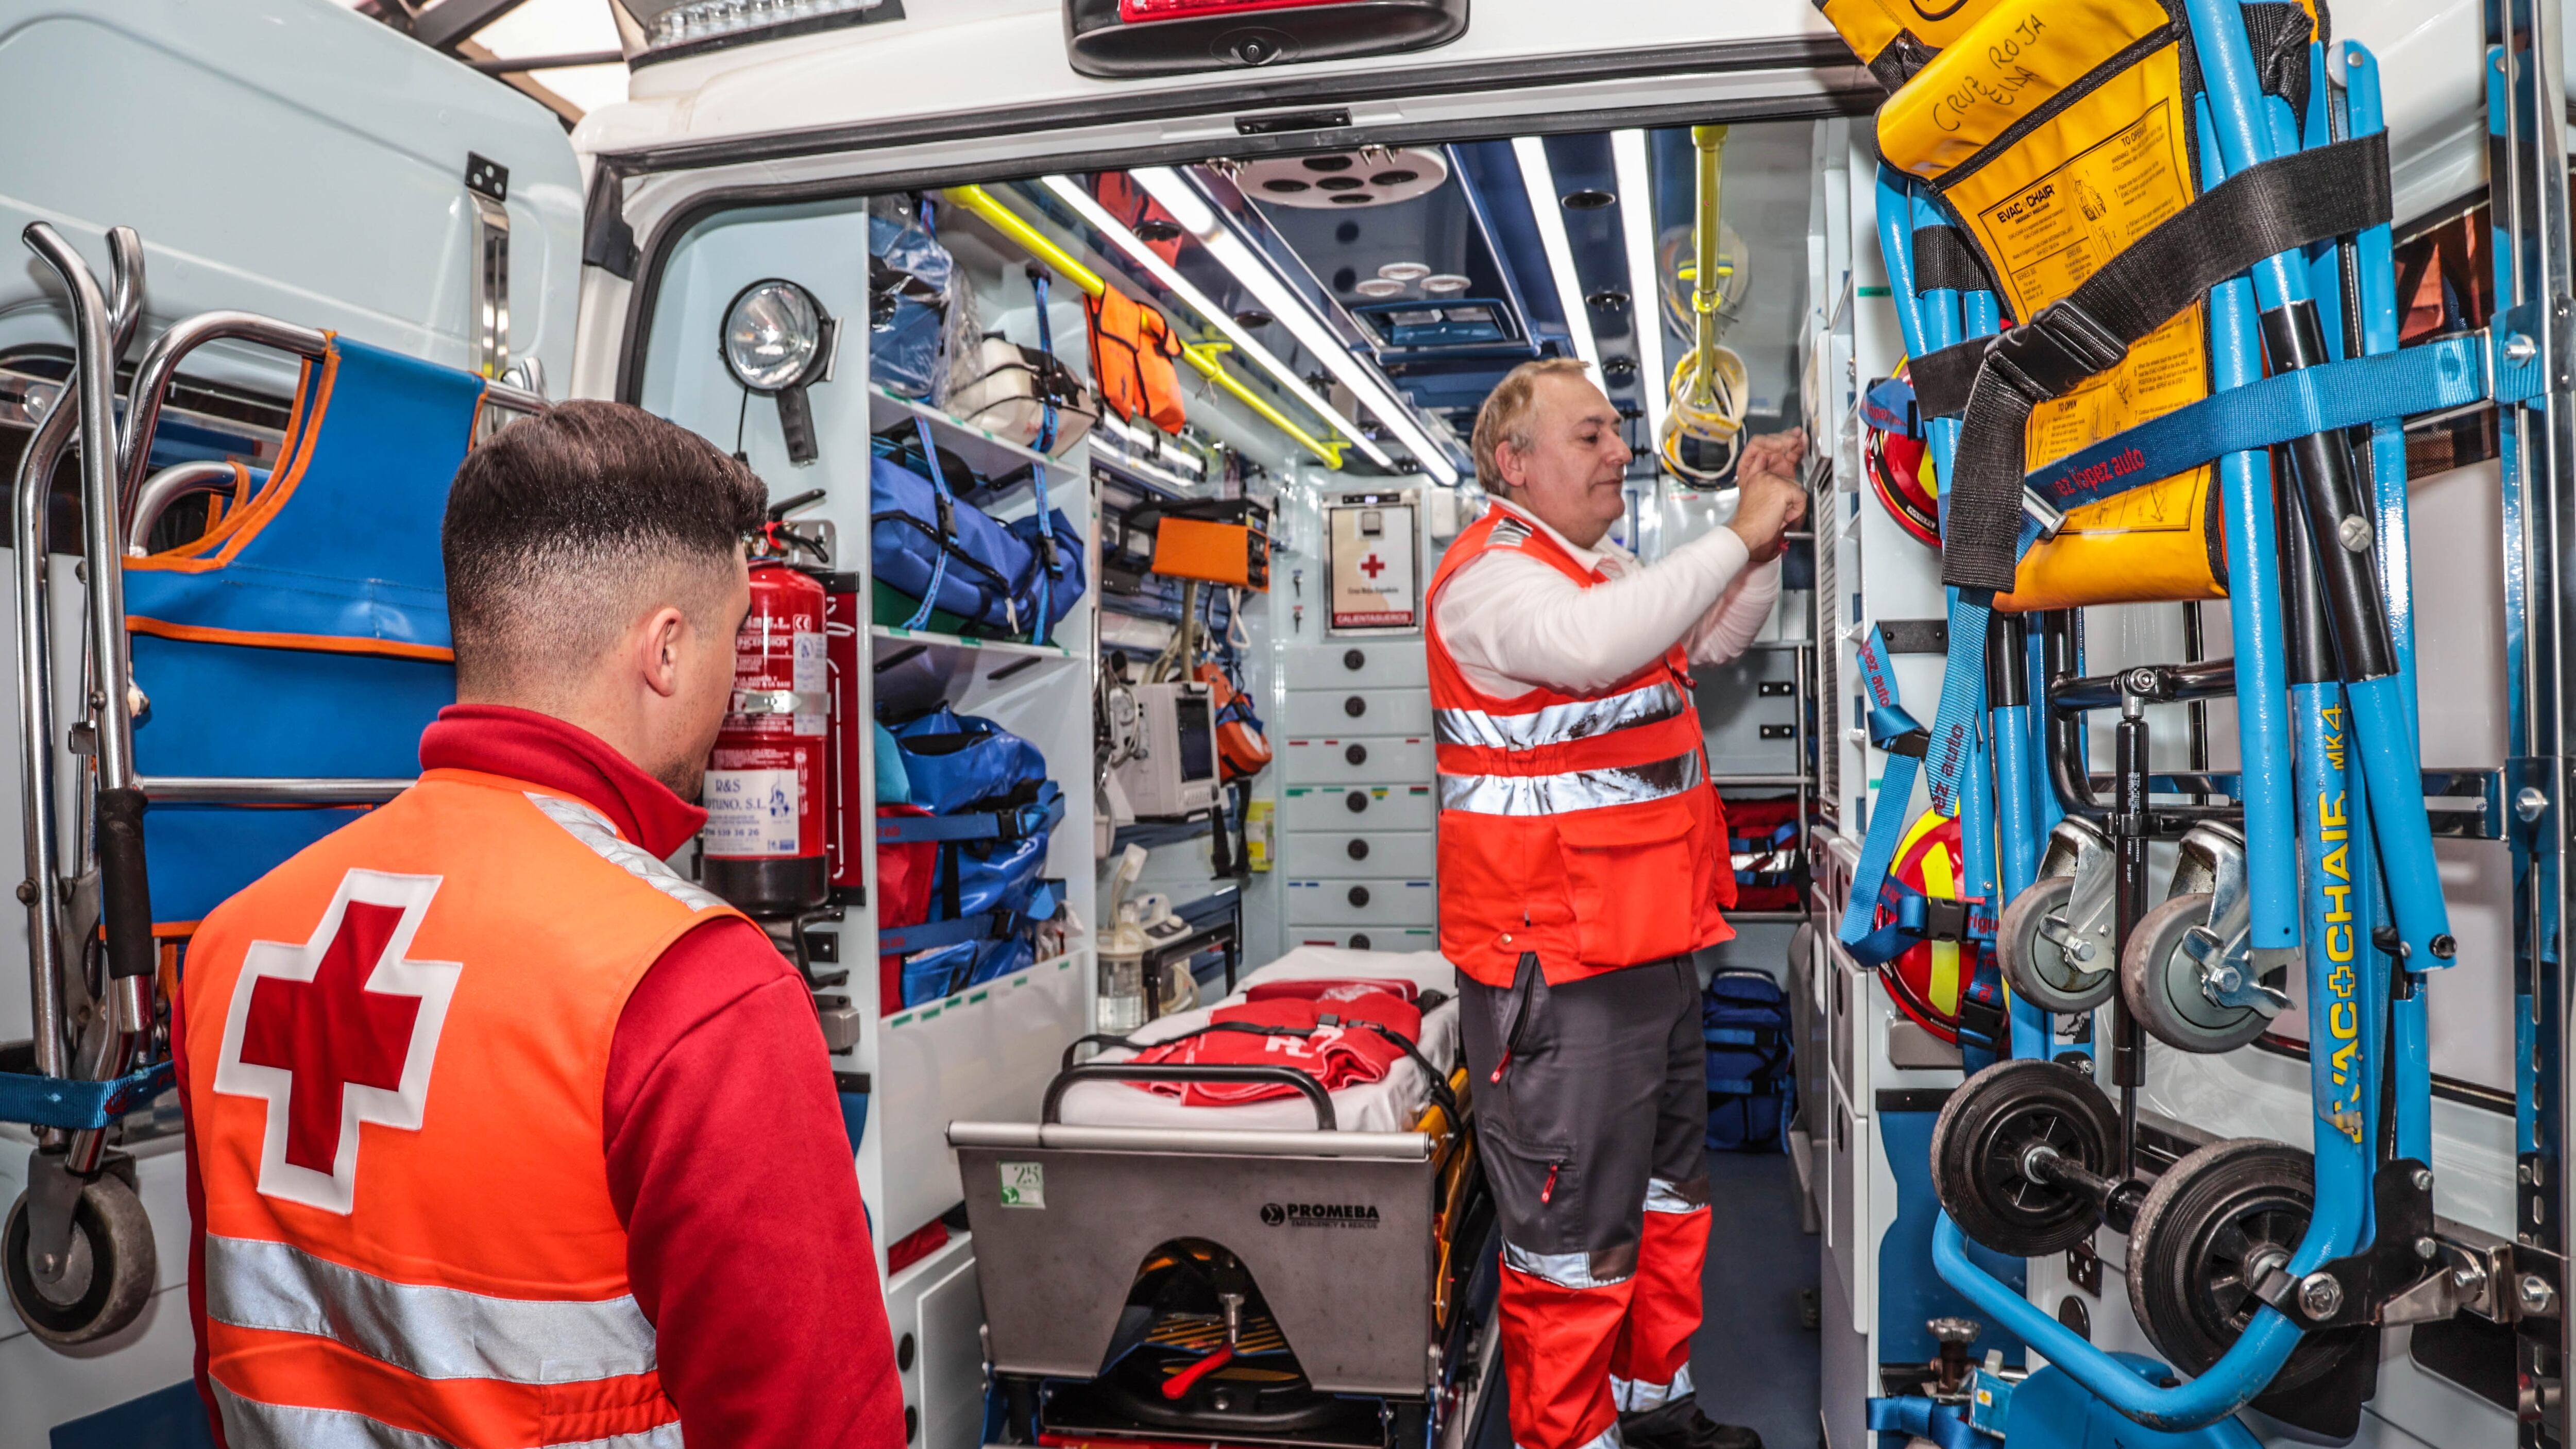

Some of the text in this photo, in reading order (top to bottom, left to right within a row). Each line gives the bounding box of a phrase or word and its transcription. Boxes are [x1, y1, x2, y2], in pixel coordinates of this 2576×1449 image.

[1989, 13, 2047, 70] ROJA
[2121, 136, 2131, 147] TO
[2110, 447, 2145, 477] auto
[1871, 674, 1890, 709] auto
[1941, 723, 1964, 778] auto
[2323, 703, 2344, 771] MK4
[1287, 1203, 1380, 1219] PROMEBA
[1291, 1219, 1337, 1229] EMERGENCY
[1348, 1221, 1379, 1230] RESCUE
